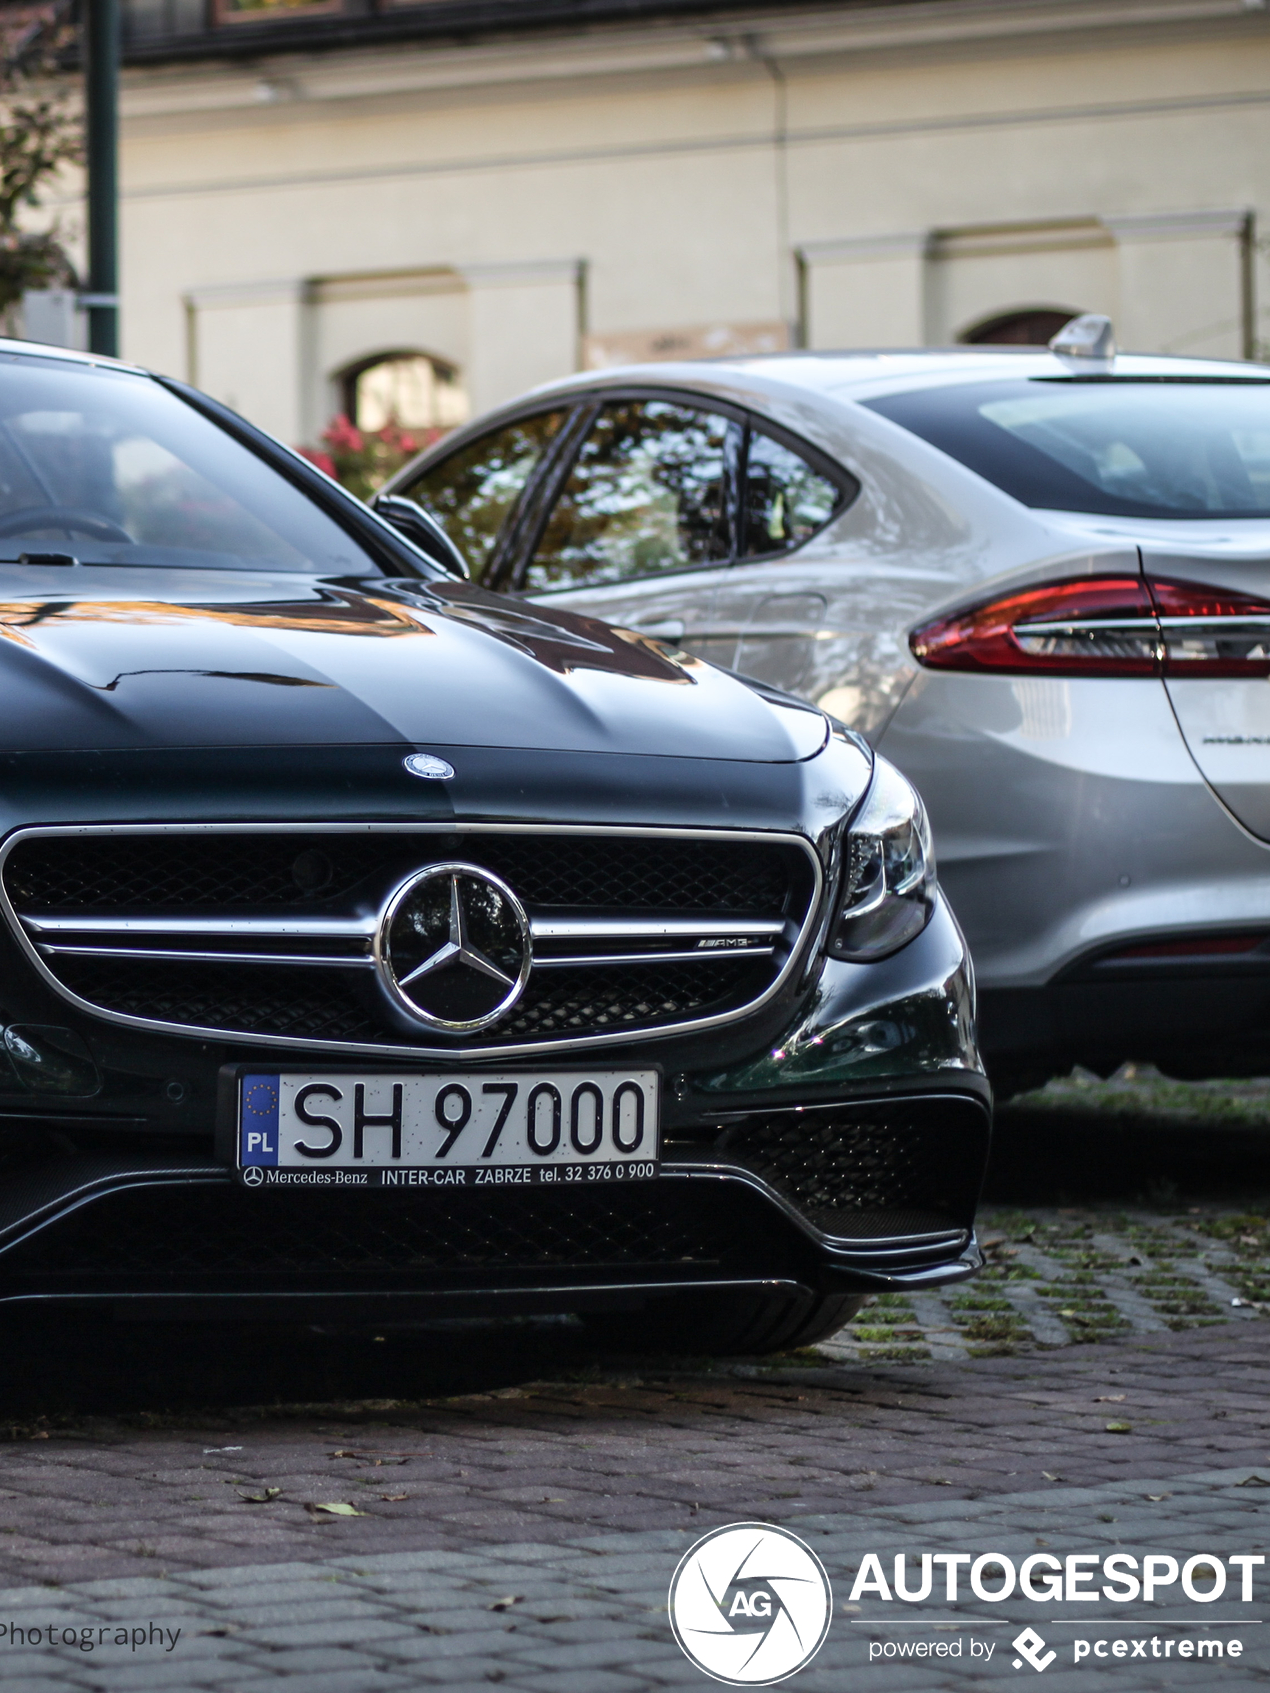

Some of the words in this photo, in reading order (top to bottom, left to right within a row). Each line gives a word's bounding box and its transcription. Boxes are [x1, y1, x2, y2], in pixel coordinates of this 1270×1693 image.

[713, 938, 748, 947] AMG
[293, 1082, 403, 1159] SH
[434, 1079, 646, 1158] 97000
[247, 1132, 273, 1152] PL
[266, 1169, 368, 1185] Mercedes-Benz
[381, 1169, 466, 1185] INTER-CAR
[475, 1167, 532, 1184] ZABRZE
[539, 1167, 561, 1182] tel.
[565, 1166, 583, 1181] 32
[587, 1165, 612, 1180] 376
[615, 1164, 625, 1179] 0
[628, 1163, 654, 1179] 900
